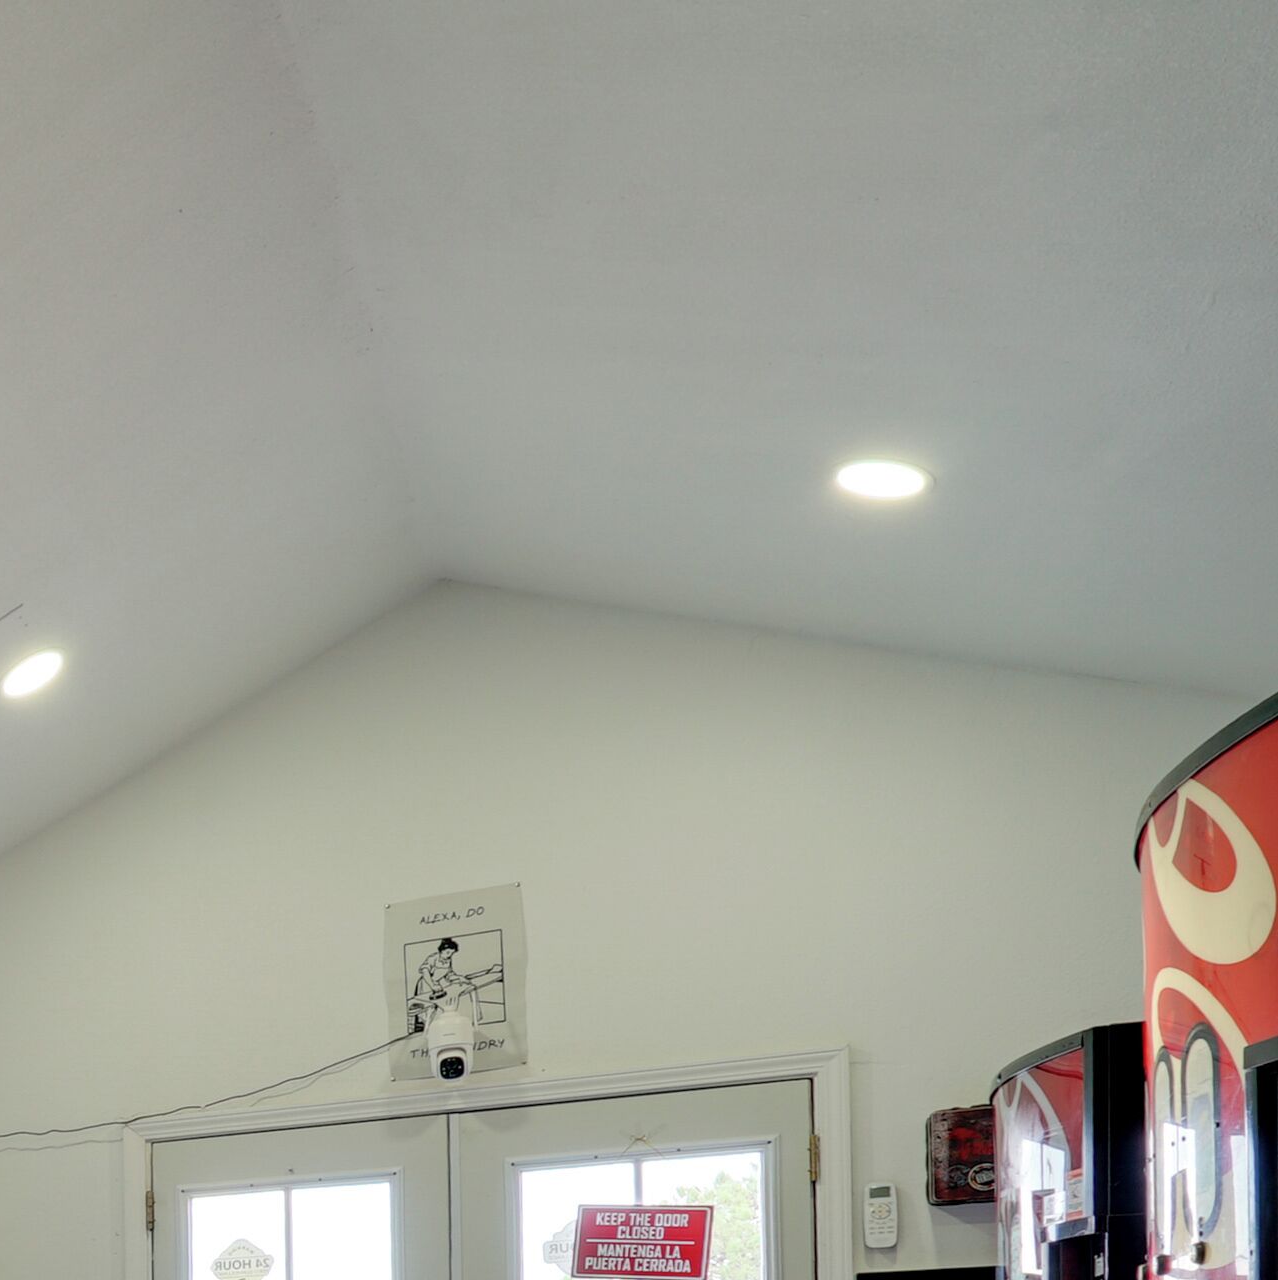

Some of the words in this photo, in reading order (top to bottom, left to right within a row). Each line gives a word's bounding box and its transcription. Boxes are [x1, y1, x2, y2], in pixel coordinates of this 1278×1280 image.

[419, 911, 461, 924] ALEXA,
[466, 907, 484, 918] DO
[412, 1049, 430, 1059] TH
[597, 1213, 626, 1226] KEEP
[630, 1213, 652, 1226] THE
[655, 1214, 689, 1227] DOOR
[617, 1226, 665, 1240] CLOSED
[597, 1244, 662, 1259] MANTENGA
[665, 1246, 681, 1259] LA
[585, 1257, 631, 1271] PUERTA
[634, 1259, 691, 1273] CERRADA
